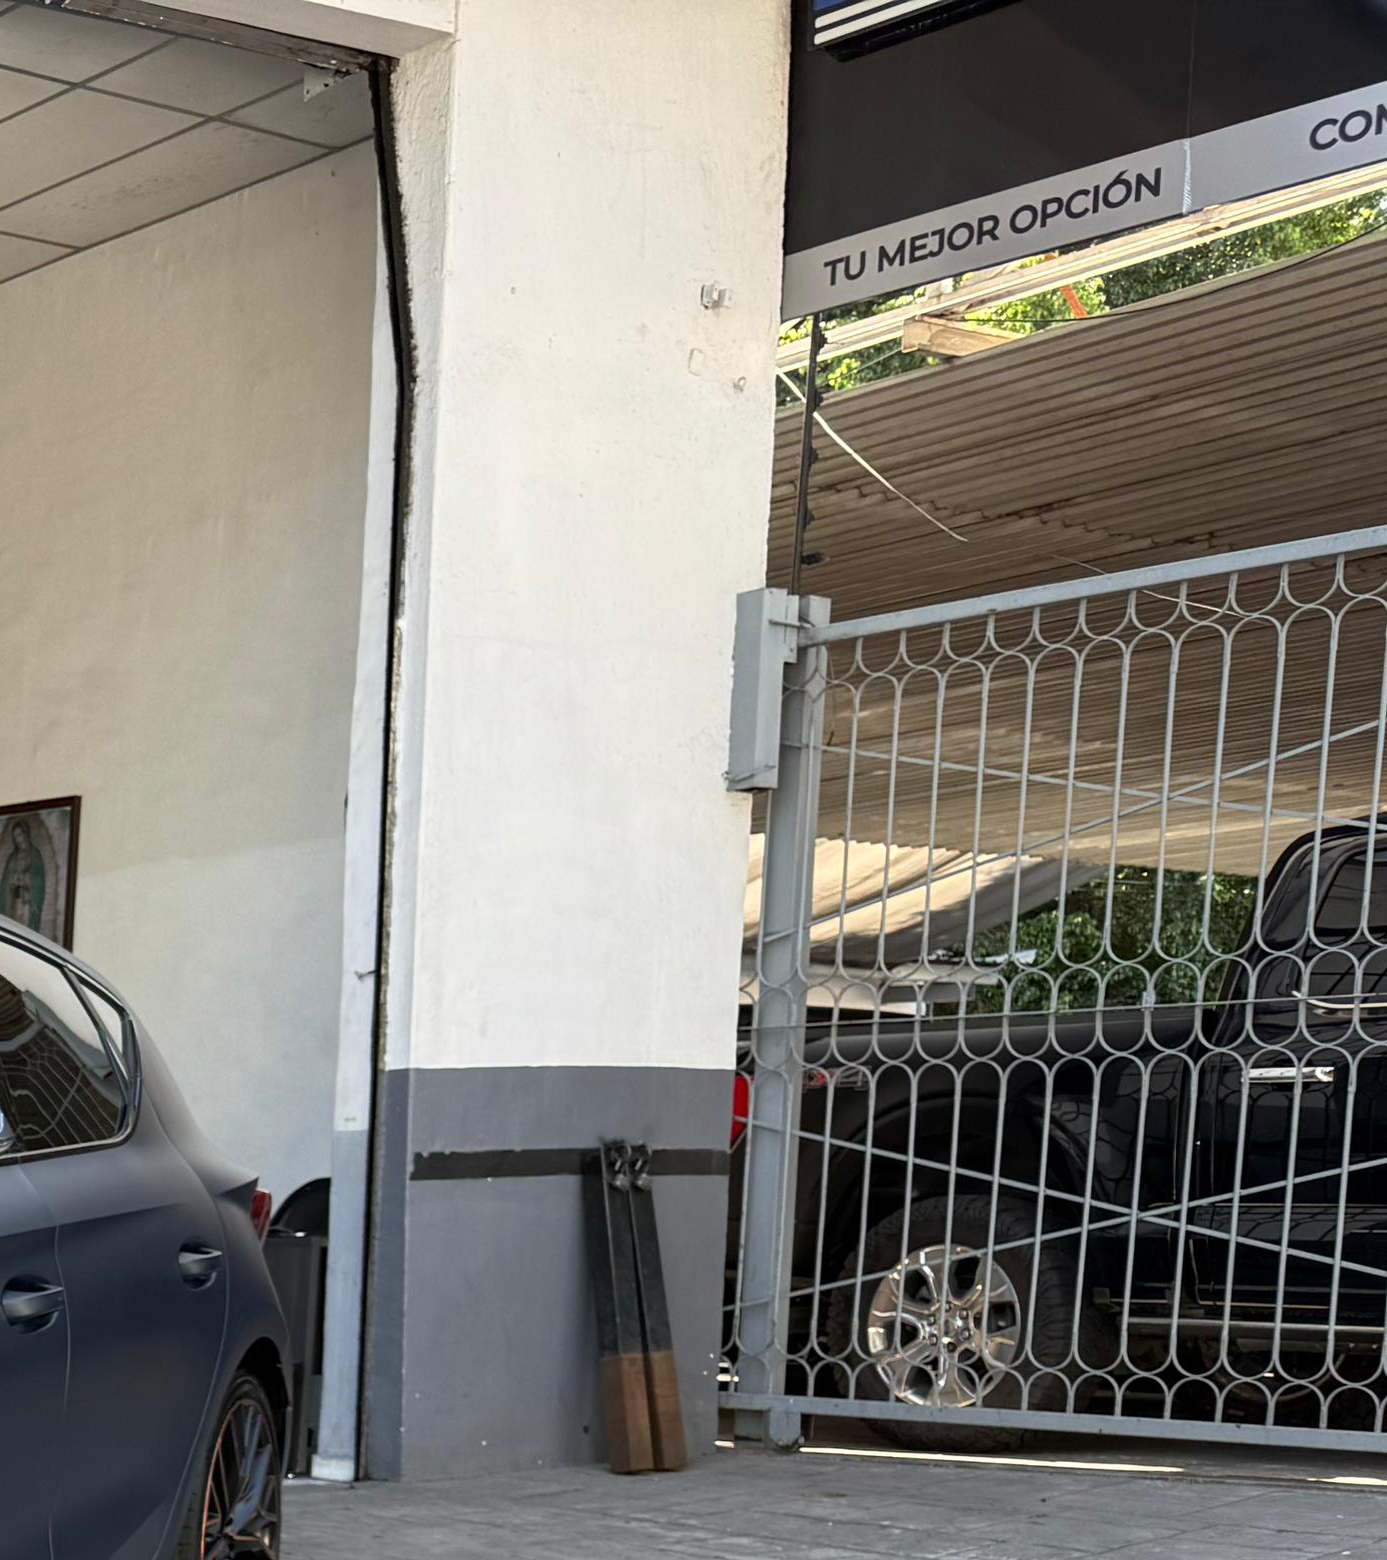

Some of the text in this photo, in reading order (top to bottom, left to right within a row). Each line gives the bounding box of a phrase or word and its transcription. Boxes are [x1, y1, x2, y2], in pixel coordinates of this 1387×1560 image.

[824, 166, 1163, 286] TU MEJOR OPCIÓN
